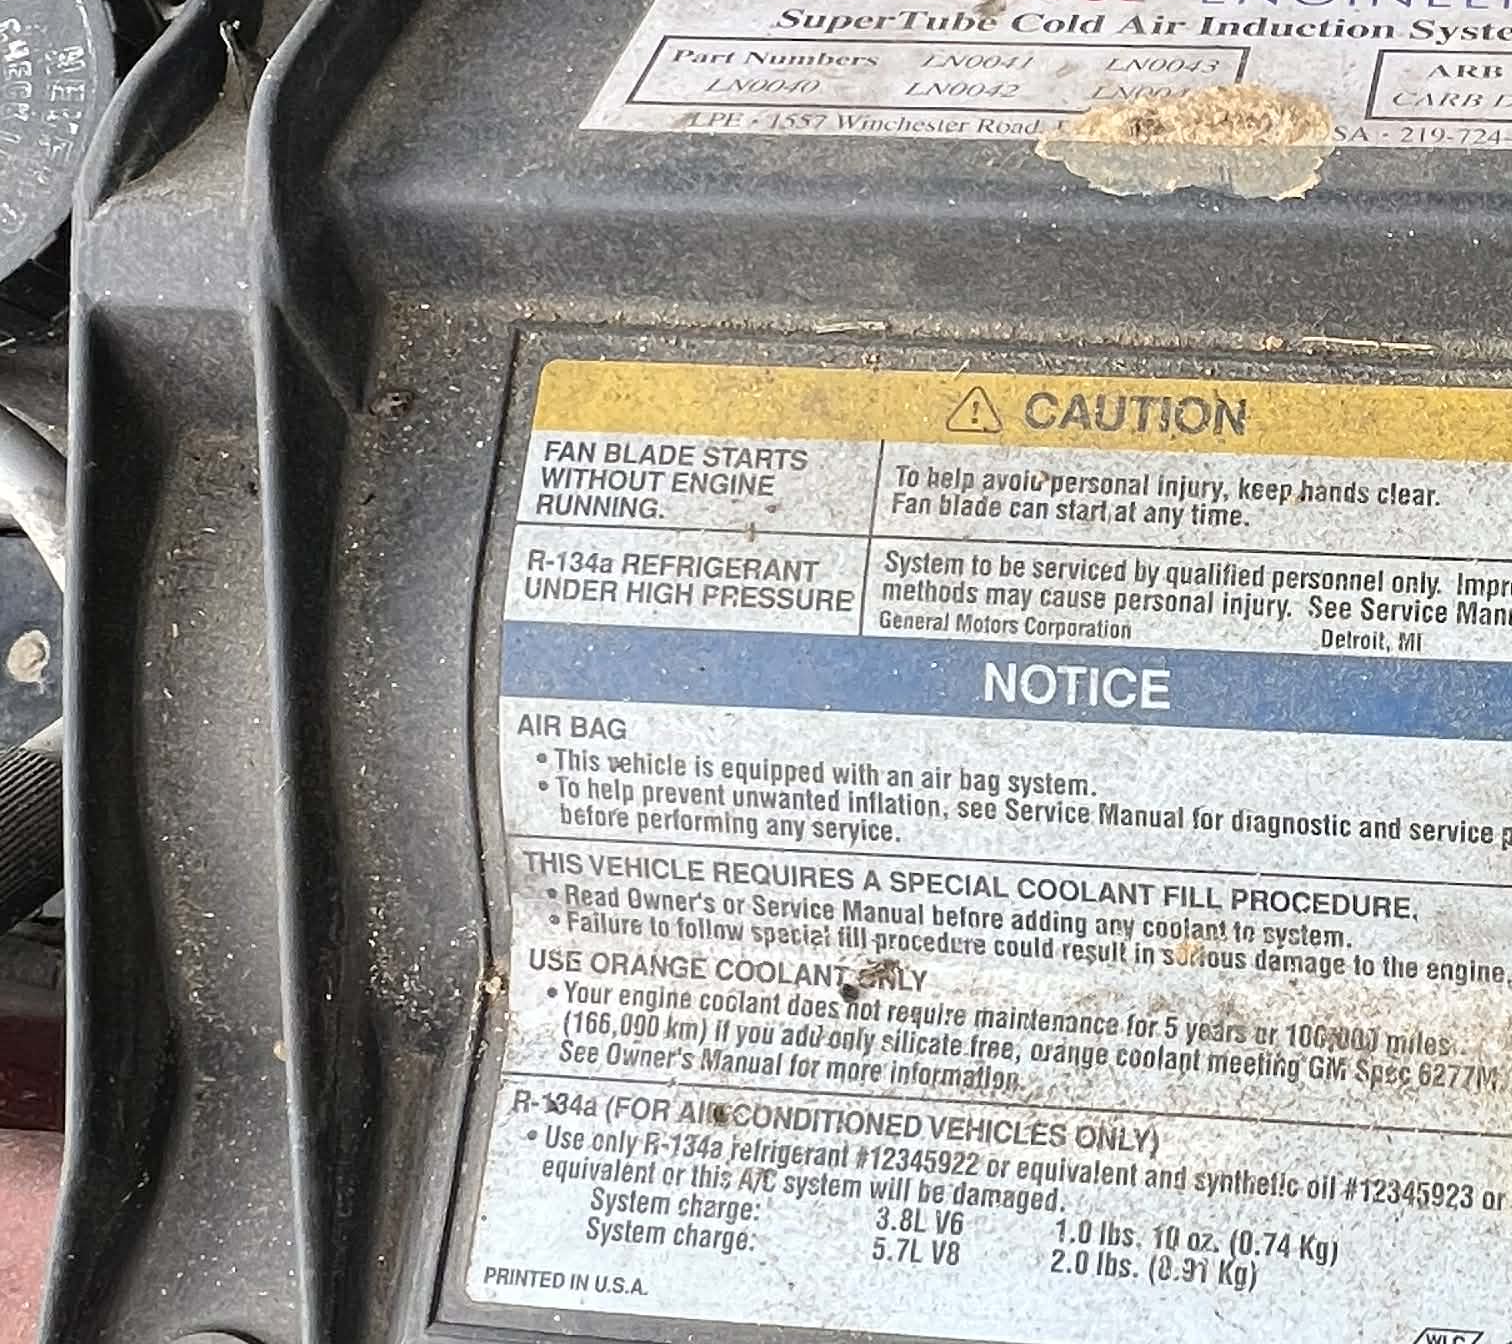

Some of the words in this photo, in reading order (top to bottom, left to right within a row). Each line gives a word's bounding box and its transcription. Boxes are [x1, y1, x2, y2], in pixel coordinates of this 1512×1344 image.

[775, 8, 997, 34] SuperTube
[1011, 12, 1105, 35] Cold
[1117, 14, 1185, 36] Air
[1200, 16, 1394, 39] Induction
[673, 49, 733, 65] Part
[745, 51, 879, 67] Numbers
[921, 55, 1034, 70] LN0041
[1105, 57, 1220, 73] LN0043
[1428, 64, 1502, 80] ARB
[704, 78, 821, 94] LN0040
[904, 82, 1019, 98] LN0042
[1393, 91, 1483, 108] CARB
[1024, 391, 1247, 435] CAUTION
[545, 440, 596, 463] FAN
[603, 442, 695, 467] BLADE
[702, 446, 809, 471] STARTS
[541, 467, 670, 493] WITHOUT
[670, 471, 776, 497] ENGINE
[535, 494, 666, 520] RUNNING.
[891, 492, 931, 516] Fan
[939, 493, 1001, 518] blade
[1009, 500, 1049, 520] can
[1055, 500, 1107, 523] start
[1114, 502, 1136, 523] at
[1143, 505, 1184, 530] any
[1191, 505, 1251, 528] time.
[527, 548, 613, 574] R-134a
[621, 552, 820, 584] REFRIGERANT
[883, 549, 965, 578] System
[971, 555, 992, 577] to
[1000, 555, 1025, 578] be
[1032, 557, 1126, 583] serviced
[1133, 560, 1160, 589] by
[1166, 561, 1264, 590] qualified
[1271, 566, 1384, 593] personnel
[1391, 570, 1441, 600] only.
[524, 575, 618, 603] UNDER
[626, 581, 694, 606] HIGH
[702, 584, 856, 612] PRESSURE
[881, 579, 978, 605] methods
[985, 589, 1032, 612] may
[1039, 591, 1106, 610] cause
[1113, 589, 1214, 615] personal
[1222, 591, 1293, 619] injury.
[1306, 595, 1352, 620] See
[1360, 597, 1448, 623] Service
[879, 610, 949, 631] General
[956, 614, 1018, 635] Motors
[1024, 617, 1132, 641] Corporation
[1320, 629, 1391, 652] Detroit,
[1398, 632, 1423, 653] MI
[984, 661, 1171, 710] NOTICE
[516, 713, 562, 737] AIR
[570, 715, 628, 741] BAG
[554, 747, 600, 772] This
[608, 752, 687, 777] vehicle
[695, 755, 714, 778] is
[721, 757, 825, 786] equipped
[832, 762, 880, 787] with
[886, 768, 913, 788] an
[920, 767, 952, 790] air
[959, 768, 1000, 797] bag
[1008, 772, 1098, 798] system.
[558, 776, 580, 799] To
[587, 777, 635, 805] help
[642, 782, 727, 807] prevent
[732, 785, 840, 812] unwanted
[848, 793, 949, 820] inflation,
[957, 800, 997, 821] see
[1005, 797, 1091, 824] Service
[1098, 803, 1184, 830] Manual
[1192, 806, 1224, 832] for
[1231, 809, 1352, 838] diagnostic
[1358, 817, 1401, 840] and
[1409, 819, 1495, 845] service
[522, 850, 584, 875] THIS
[591, 854, 705, 882] VEHICLE
[713, 861, 855, 890] REQUIRES
[862, 869, 882, 893] A
[889, 871, 1009, 900] SPECIAL
[1016, 877, 1156, 906] COOLANT
[1163, 884, 1223, 909] FILL
[590, 1187, 671, 1217] System
[677, 1195, 760, 1225] charge:
[875, 1206, 927, 1233] 3.8L
[934, 1210, 965, 1236] V6
[1055, 1218, 1093, 1245] 1.0
[1099, 1221, 1143, 1249] lbs.
[1229, 1228, 1290, 1258] (0.74
[1299, 1233, 1340, 1268] Kg)
[586, 1216, 666, 1247] System
[672, 1224, 755, 1255] charge:
[872, 1236, 923, 1264] 5.7L
[931, 1240, 961, 1266] V8
[1050, 1248, 1089, 1276] 2.0
[1095, 1252, 1139, 1279] lbs.
[1218, 1258, 1257, 1292] Kg)
[483, 1266, 565, 1289] PRINTED
[570, 1270, 589, 1291] IN
[594, 1273, 649, 1297] U.S.A.
